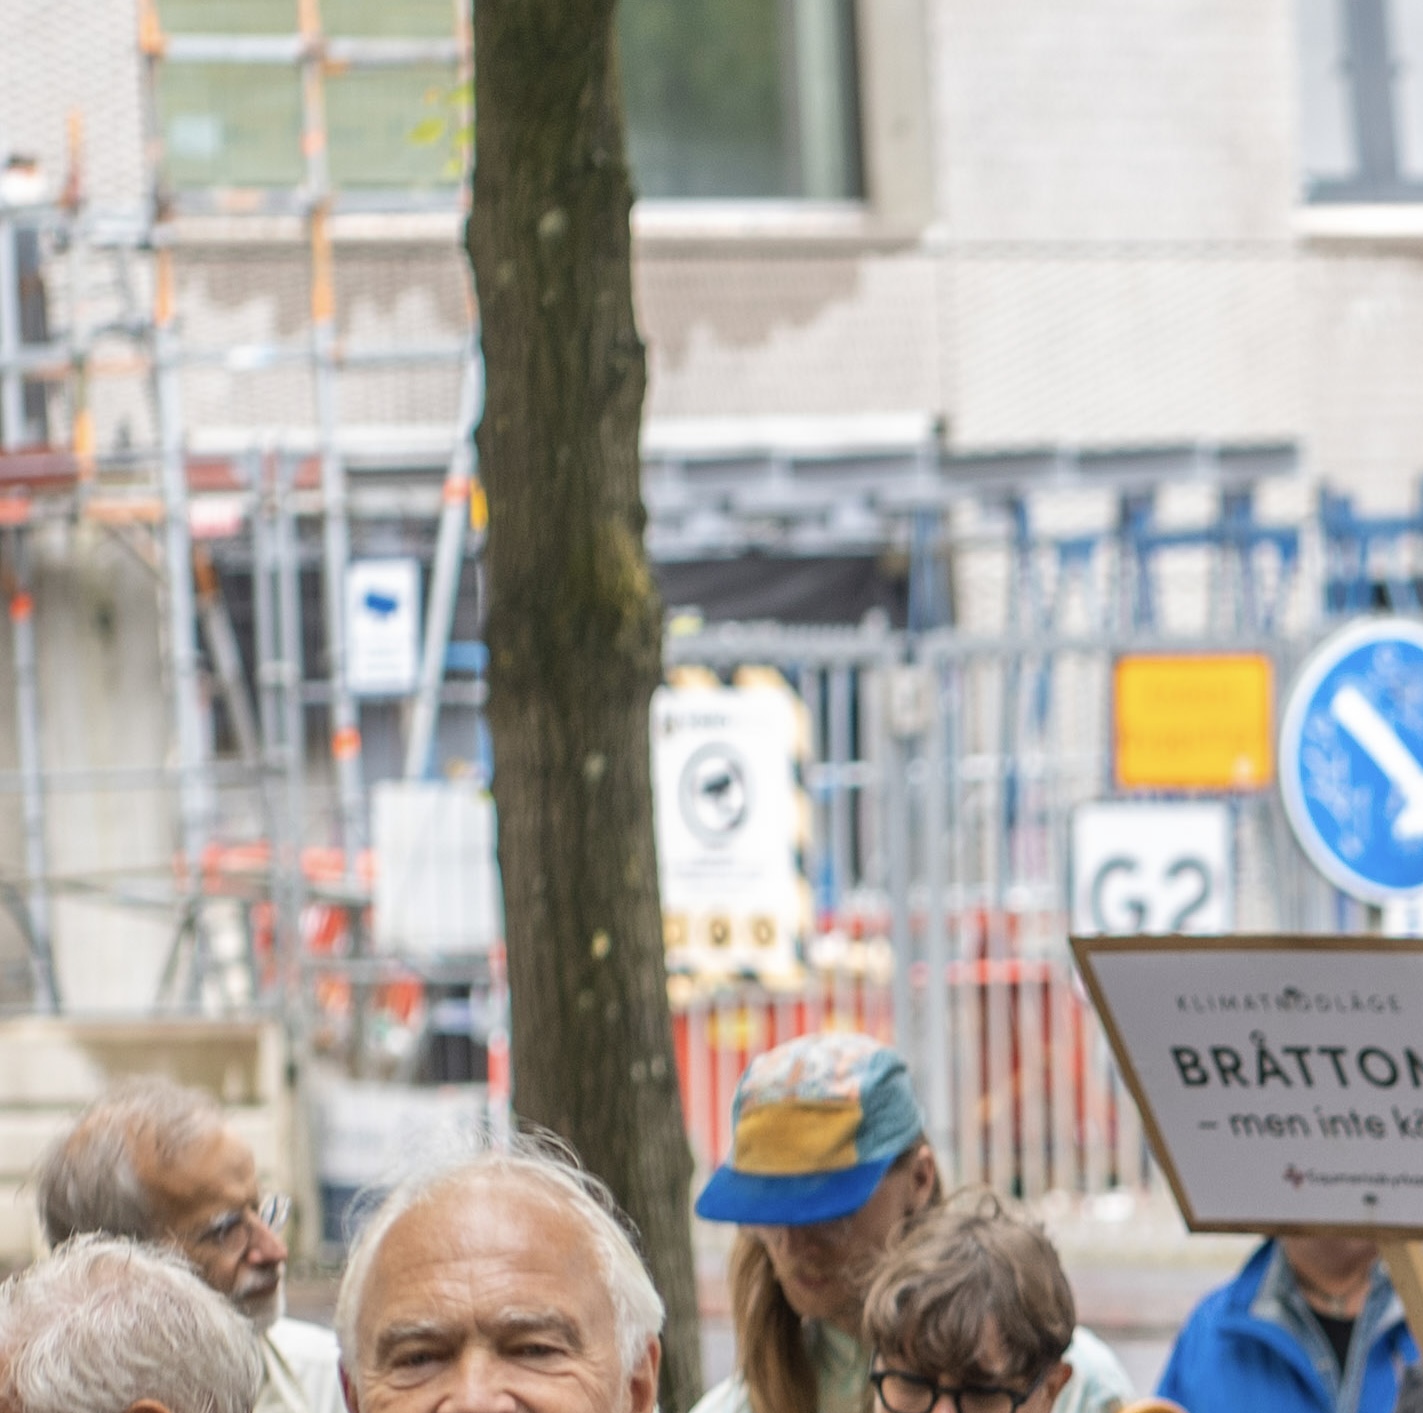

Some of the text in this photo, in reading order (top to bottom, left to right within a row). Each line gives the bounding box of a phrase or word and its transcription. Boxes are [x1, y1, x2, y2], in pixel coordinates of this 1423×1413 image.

[1090, 858, 1213, 937] G2
[1228, 1111, 1309, 1138] men
[1315, 1106, 1387, 1139] inte
